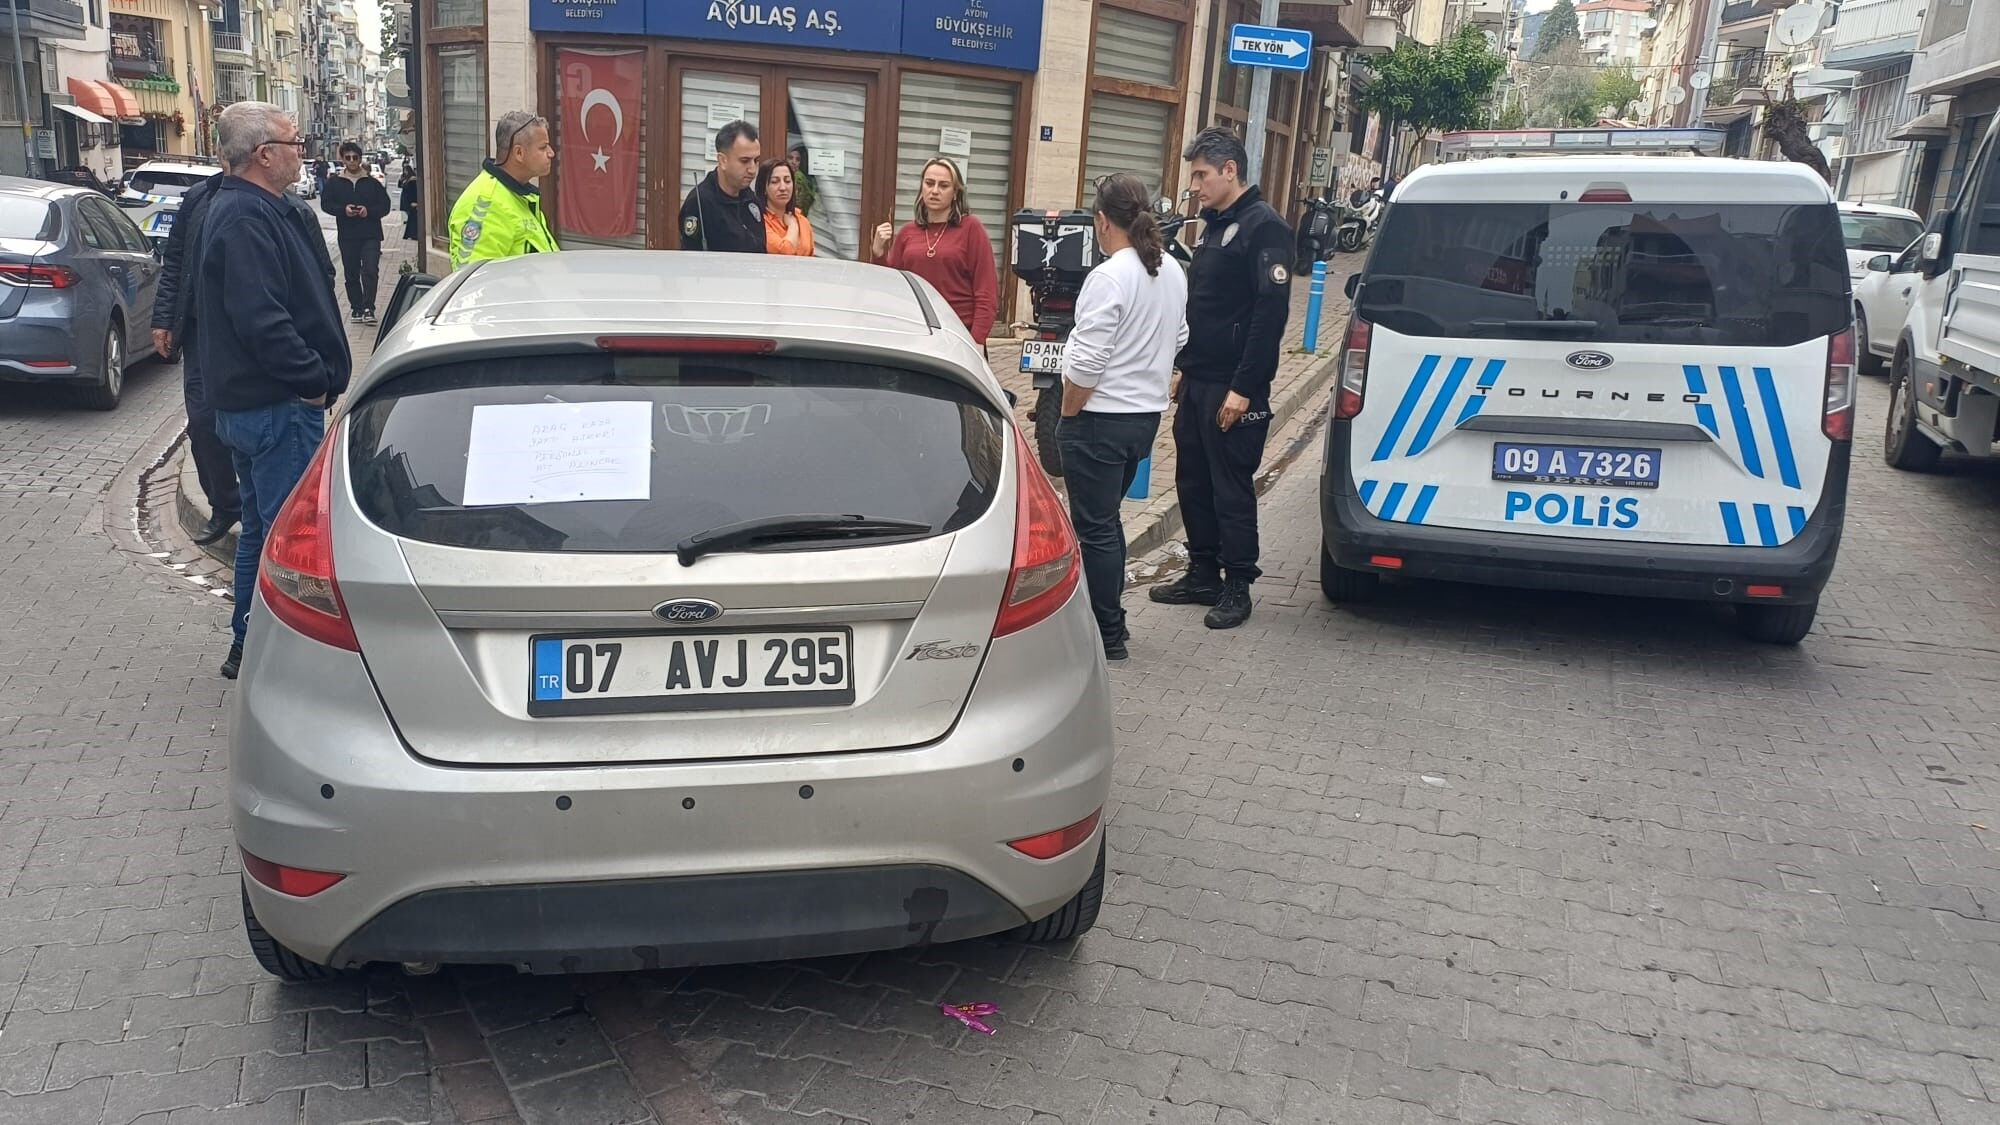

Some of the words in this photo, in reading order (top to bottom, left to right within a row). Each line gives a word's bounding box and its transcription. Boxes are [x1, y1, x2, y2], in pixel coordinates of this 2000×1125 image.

[964, 9, 988, 18] AYDIN
[805, 9, 842, 36] A.Ş.
[936, 16, 1013, 38] BÜYÜKŞEHİR
[1242, 40, 1261, 52] TEK
[1263, 40, 1284, 54] YÖN
[162, 214, 173, 222] 09
[1025, 342, 1041, 354] 09
[1575, 352, 1605, 367] Ford
[1475, 386, 1701, 403] TOURNEO
[1504, 448, 1540, 474] 09
[1547, 450, 1568, 475] A
[1578, 451, 1652, 479] 7326
[1535, 475, 1613, 486] BERK
[667, 604, 708, 619] Ford
[539, 675, 560, 689] TR
[566, 643, 623, 694] 07
[665, 639, 748, 690] AVJ
[763, 637, 844, 687] 295
